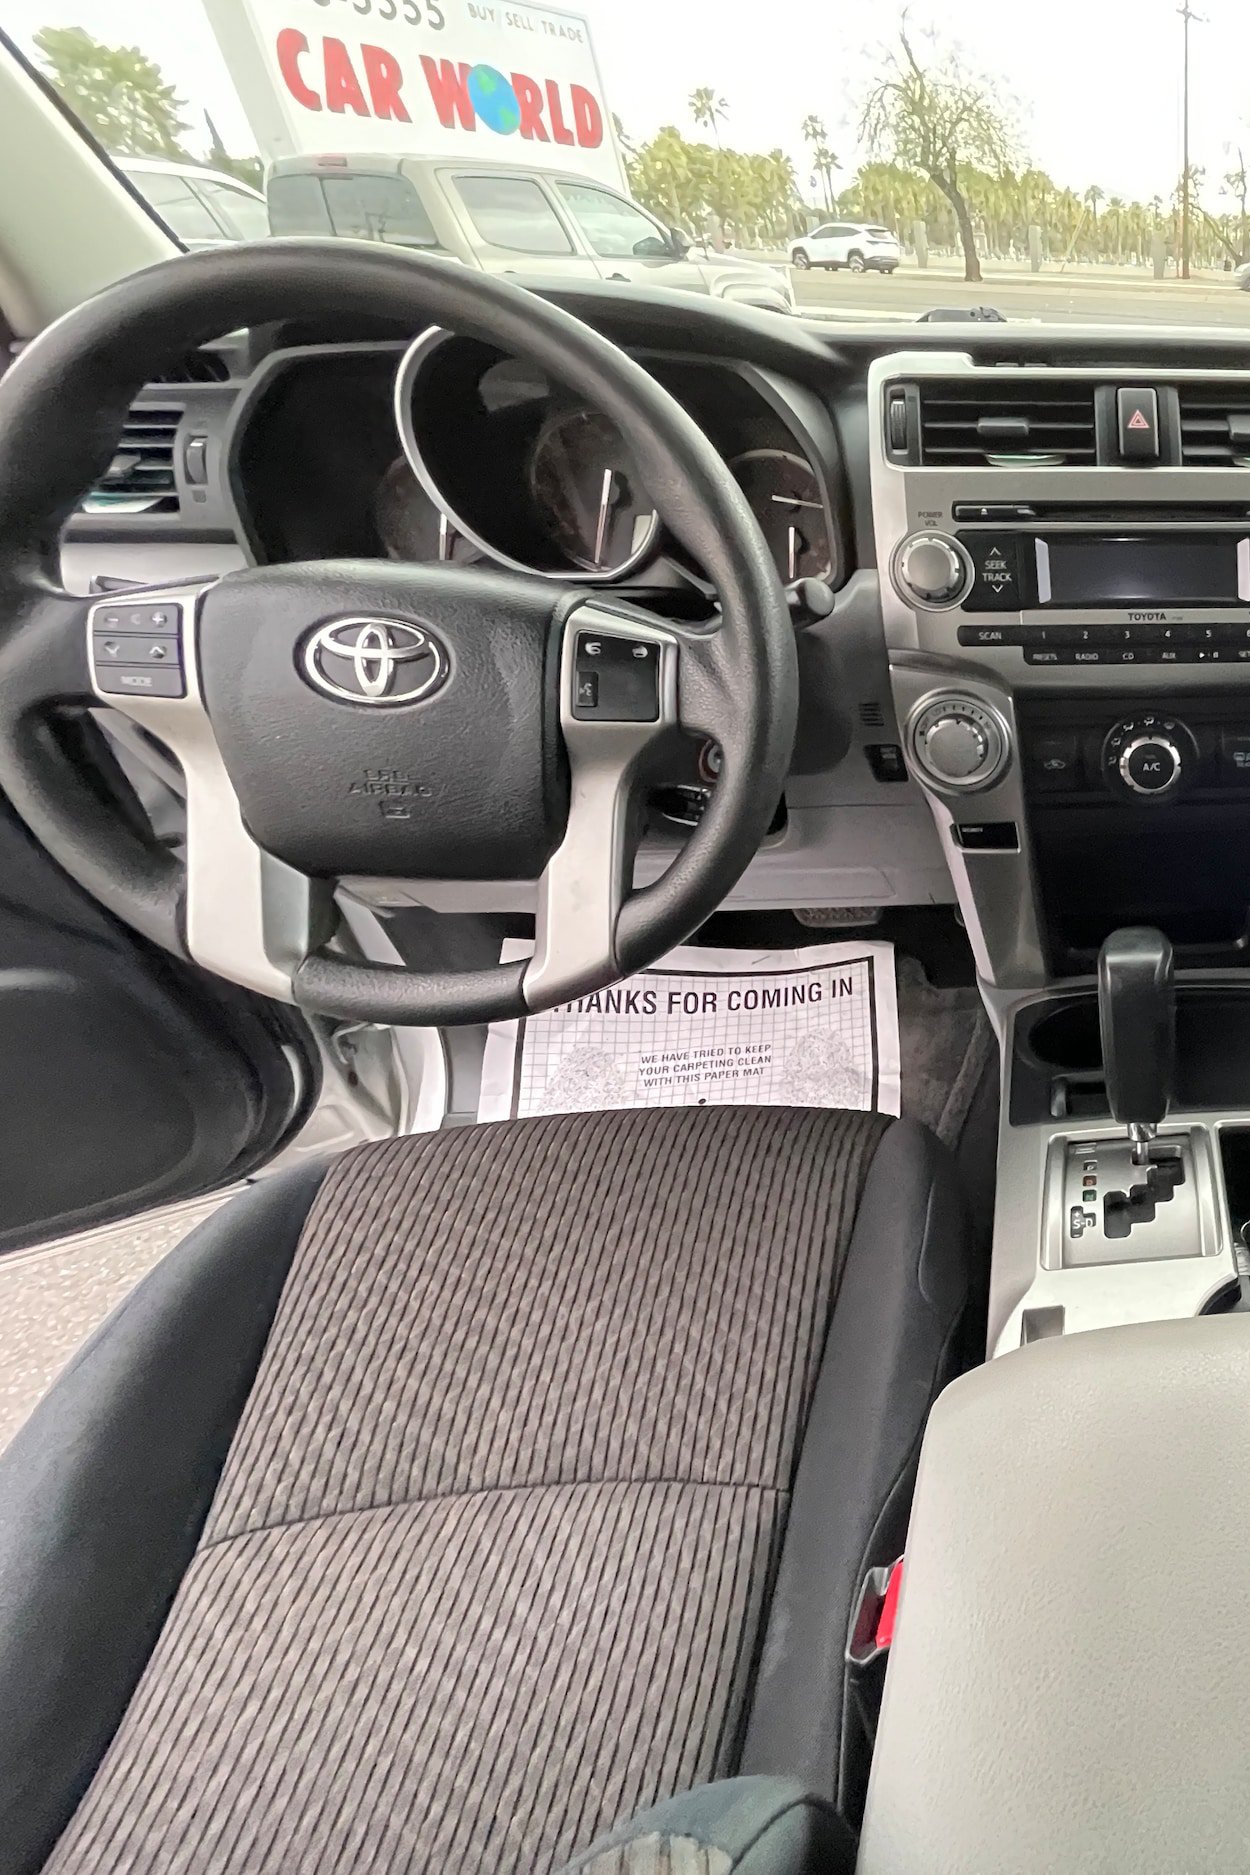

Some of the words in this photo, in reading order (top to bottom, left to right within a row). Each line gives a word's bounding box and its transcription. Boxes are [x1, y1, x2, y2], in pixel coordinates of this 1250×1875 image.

[468, 3, 495, 21] BUY
[506, 12, 534, 31] SELL
[541, 20, 584, 43] TRADE
[276, 27, 413, 123] CAR
[985, 560, 1007, 569] SEEK
[982, 573, 1012, 582] TRACK
[1127, 612, 1167, 621] TOYOTA
[979, 631, 1002, 640] SCAN
[1075, 652, 1099, 660] RADIO
[1122, 652, 1134, 660] CD
[1143, 762, 1160, 771] A/C
[554, 989, 657, 1014] ANKS
[667, 991, 717, 1014] FOR
[727, 982, 822, 1011] COMING
[831, 976, 853, 998] IN
[641, 1055, 657, 1064] WE
[661, 1052, 689, 1062] HAVE
[693, 1048, 724, 1059] TRIED
[729, 1047, 741, 1055] TO
[745, 1044, 771, 1053] KEEP
[639, 1066, 669, 1076] YOUR
[673, 1058, 734, 1073] CARPETING
[738, 1055, 772, 1066] CLEAN
[644, 1077, 672, 1087] WITH
[677, 1074, 701, 1083] THIS
[704, 1070, 739, 1081] PAPER
[743, 1067, 765, 1076] MAT
